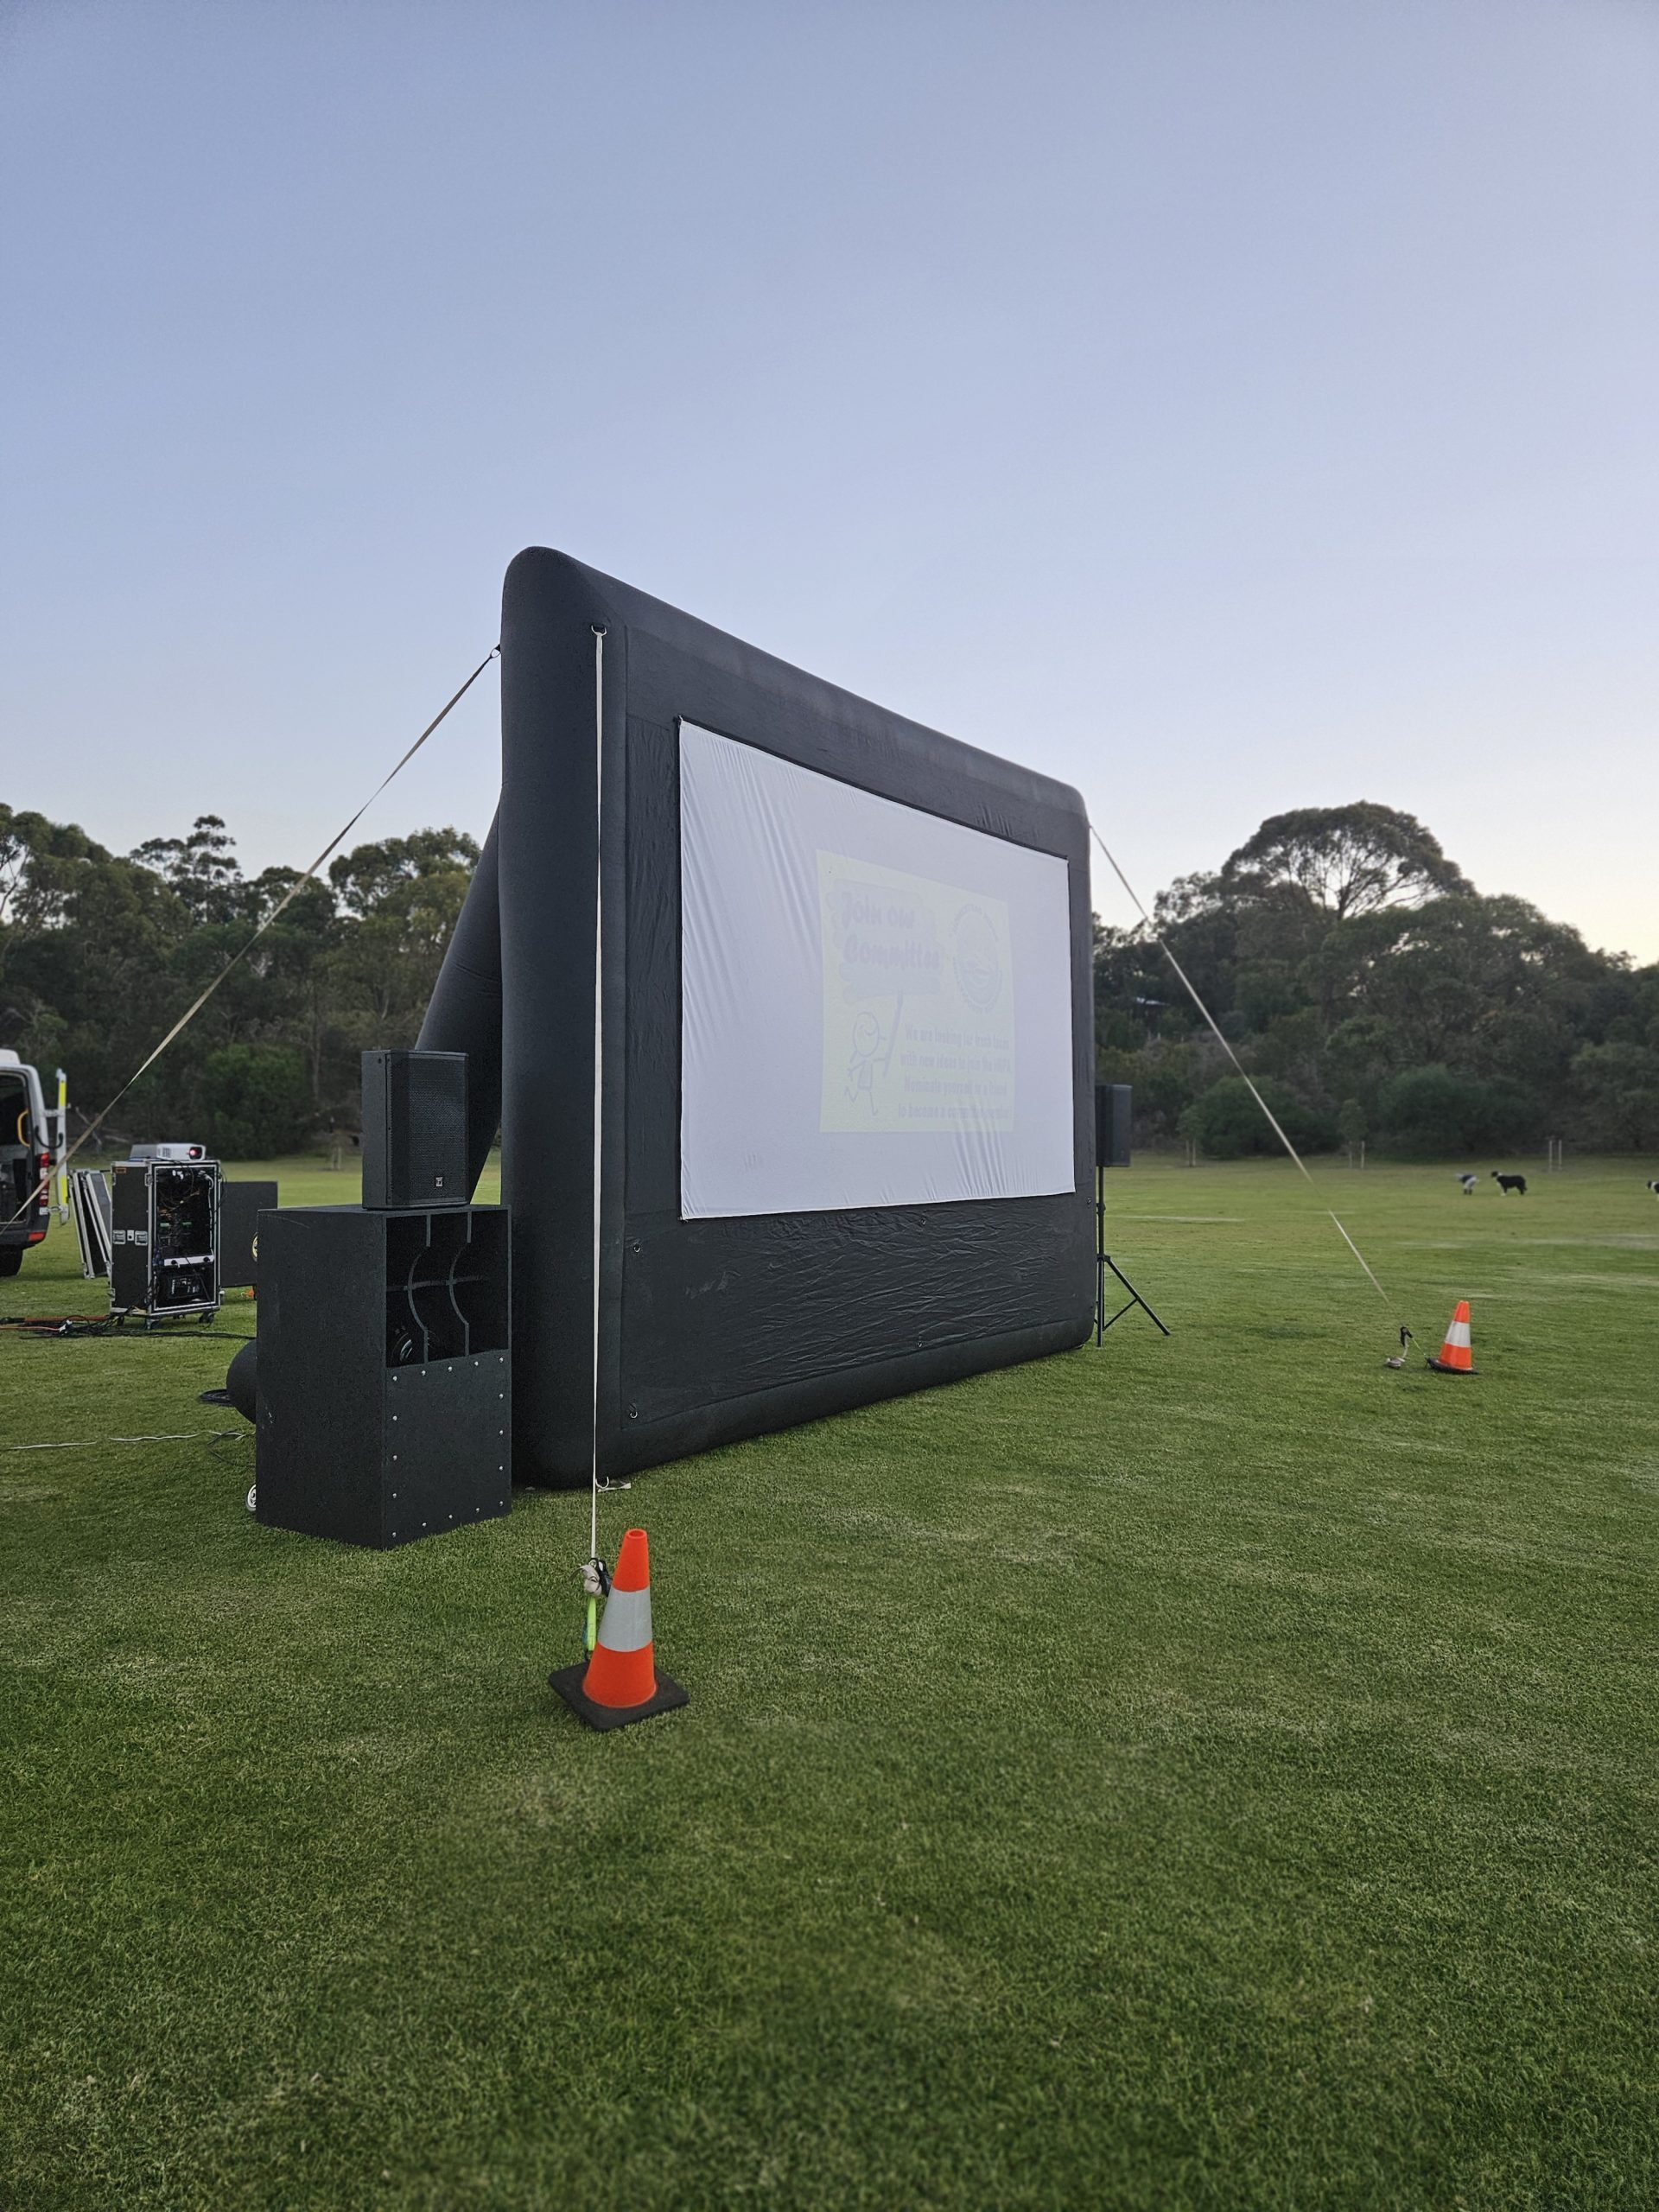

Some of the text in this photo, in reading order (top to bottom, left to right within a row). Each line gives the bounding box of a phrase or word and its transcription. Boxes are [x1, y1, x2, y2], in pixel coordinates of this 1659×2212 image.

[842, 892, 882, 930] Join
[887, 906, 914, 930] our
[843, 933, 940, 970] Committee
[905, 1023, 918, 1041] We
[920, 1030, 932, 1042] are
[935, 1027, 962, 1047] looking
[900, 1051, 917, 1066] with
[919, 1055, 934, 1067] new
[908, 1103, 938, 1118] become
